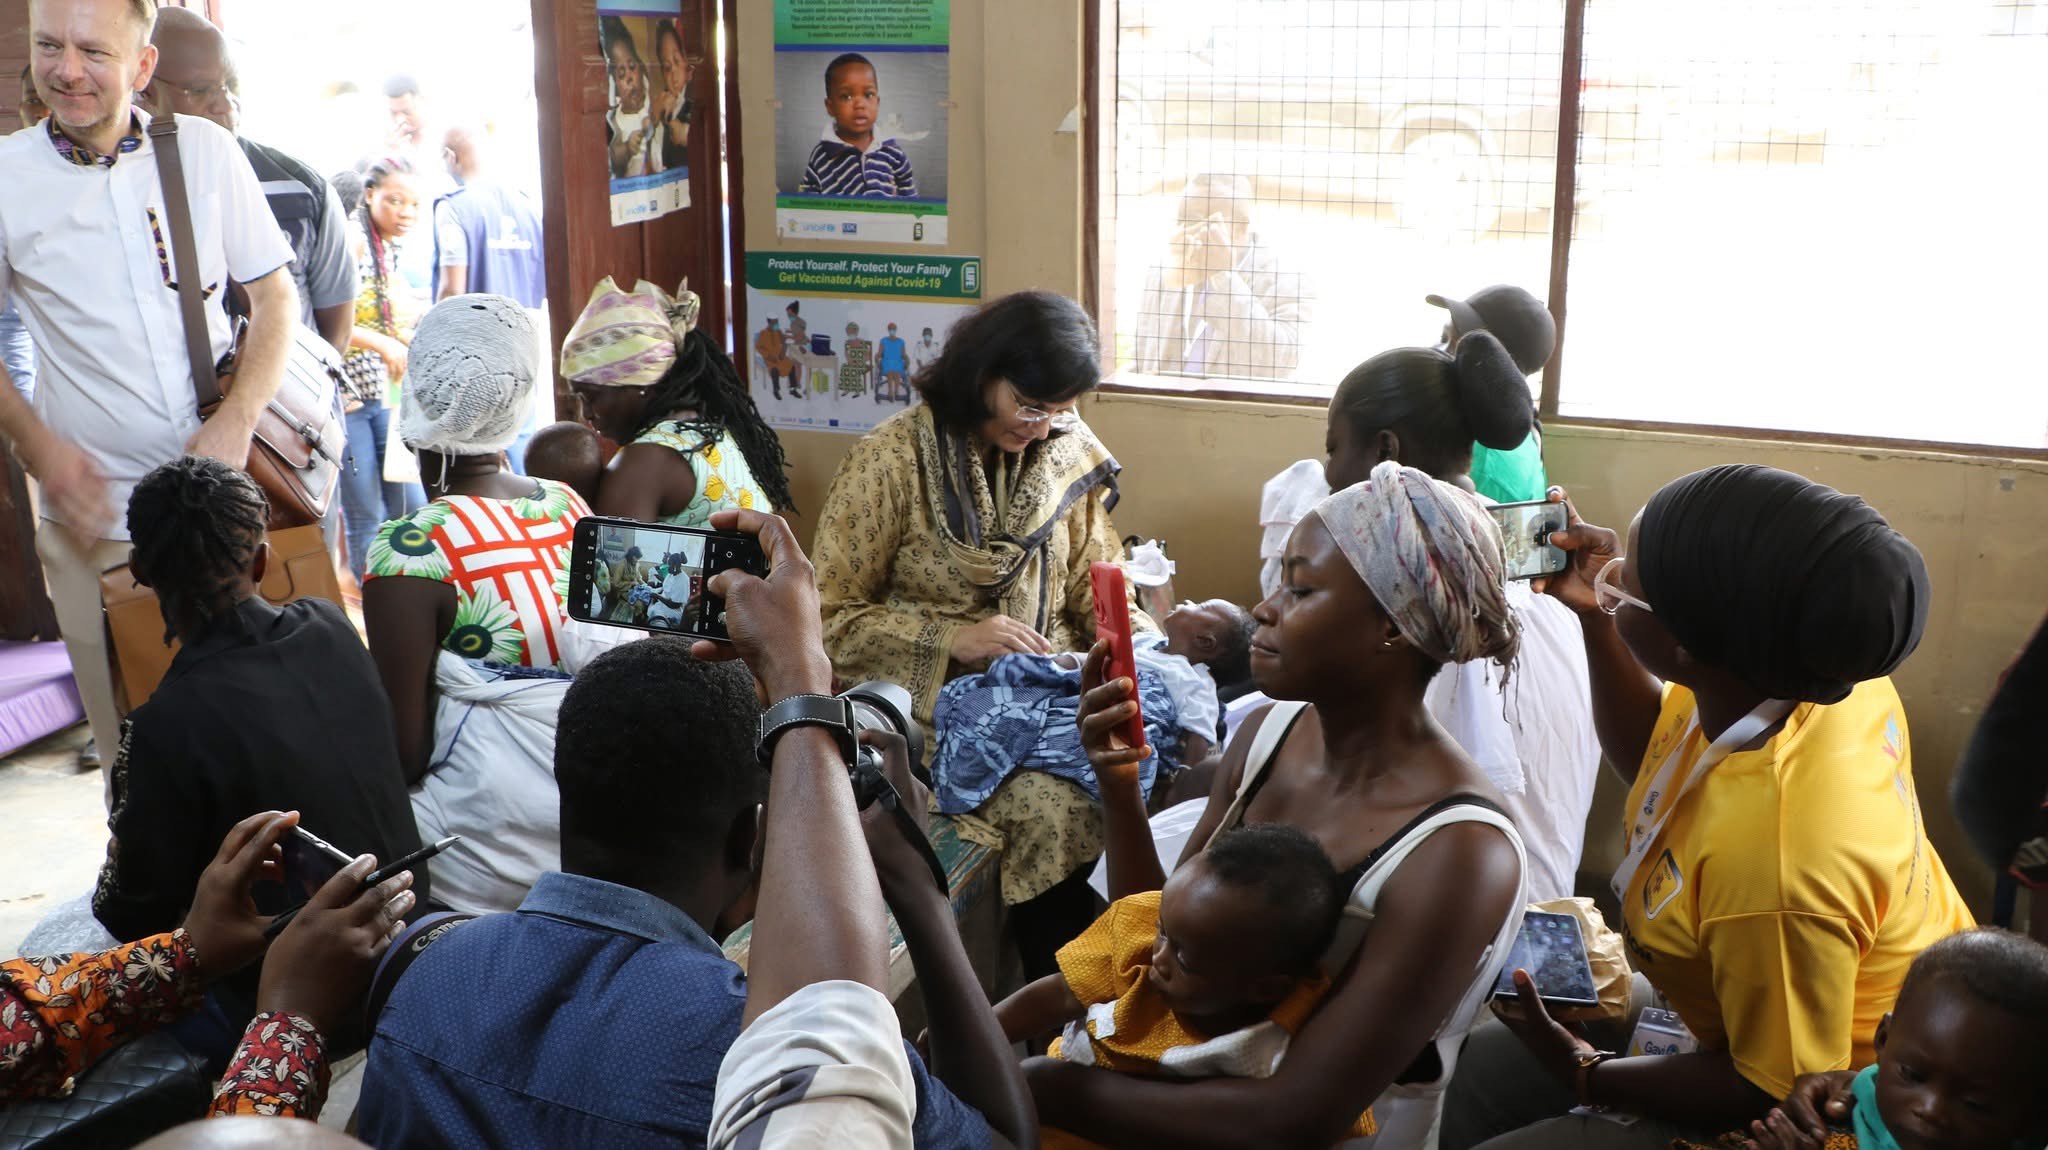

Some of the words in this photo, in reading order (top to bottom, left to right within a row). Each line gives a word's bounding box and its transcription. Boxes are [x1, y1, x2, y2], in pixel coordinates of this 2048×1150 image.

[768, 258, 803, 270] Protect
[806, 259, 849, 271] Yourself.
[851, 261, 888, 273] Protect
[890, 262, 915, 274] Your
[916, 263, 951, 278] Family
[779, 272, 796, 283] Get
[798, 272, 851, 285] Vaccinated
[853, 274, 894, 287] Against
[895, 275, 941, 289] Covid-19
